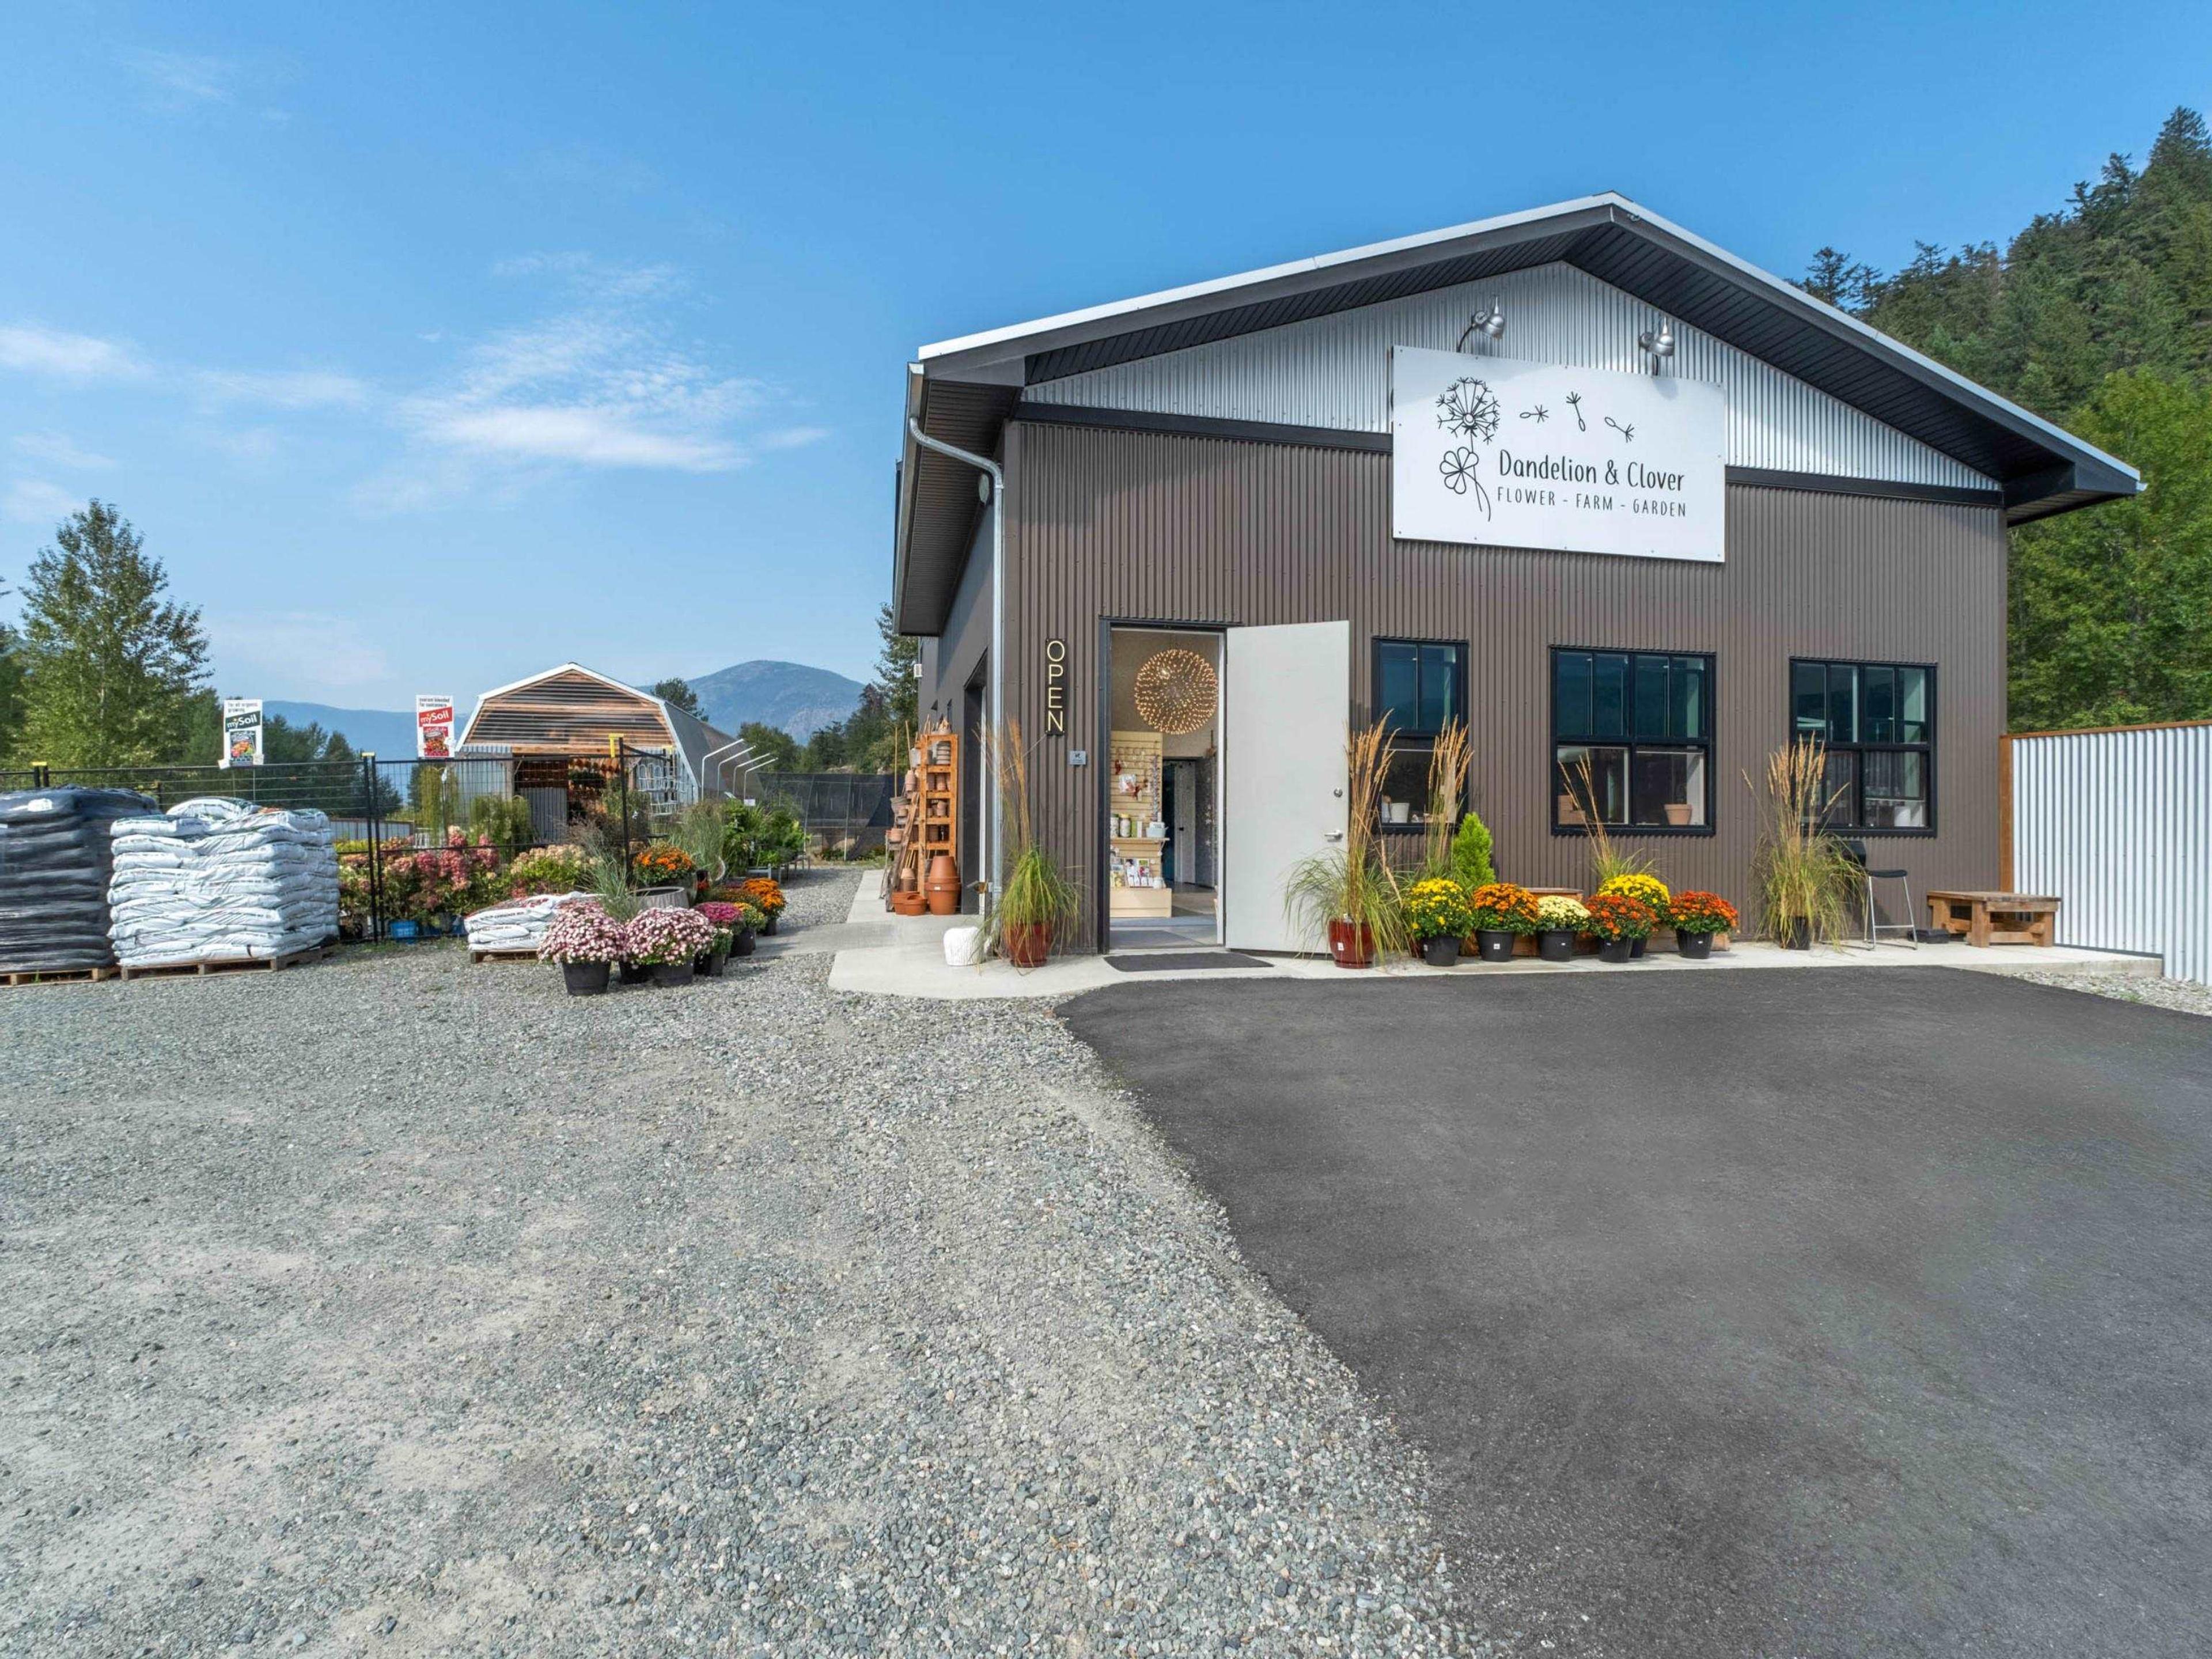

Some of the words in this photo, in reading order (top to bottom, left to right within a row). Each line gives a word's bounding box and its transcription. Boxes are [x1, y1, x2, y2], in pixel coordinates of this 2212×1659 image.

[1499, 449, 1597, 483] Dandelion
[1604, 459, 1620, 485] &
[1627, 462, 1685, 491] Clover
[1498, 487, 1555, 505] FLOWER
[1576, 493, 1612, 510] FARM
[1633, 499, 1685, 517] GARDEN
[1047, 640, 1065, 732] OPEN
[227, 714, 257, 729] mySoil
[421, 710, 449, 724] mySoil
